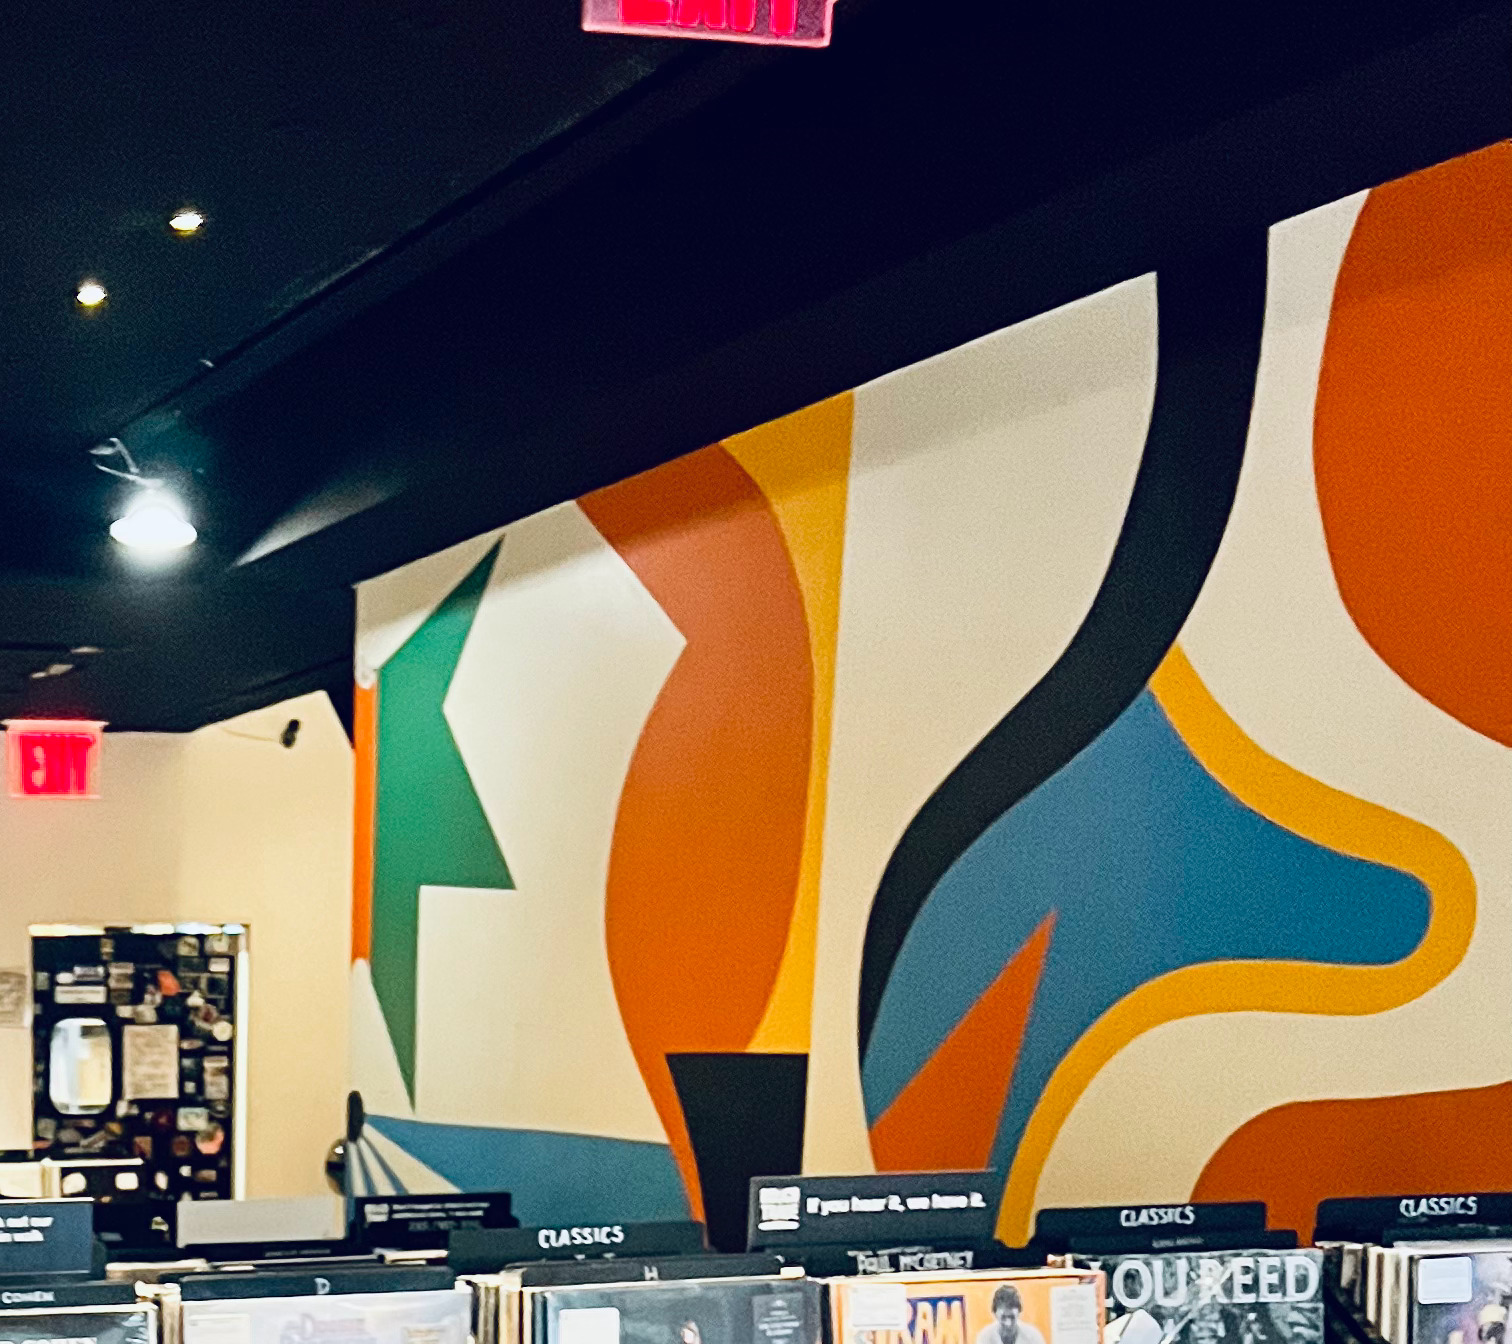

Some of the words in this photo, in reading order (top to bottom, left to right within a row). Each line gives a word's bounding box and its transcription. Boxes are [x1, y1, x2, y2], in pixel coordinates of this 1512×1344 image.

[1121, 1206, 1195, 1227] CLASSICS
[1400, 1196, 1478, 1218] CLASSICS
[538, 1226, 624, 1249] CLASSICS
[1199, 1255, 1319, 1304] REED
